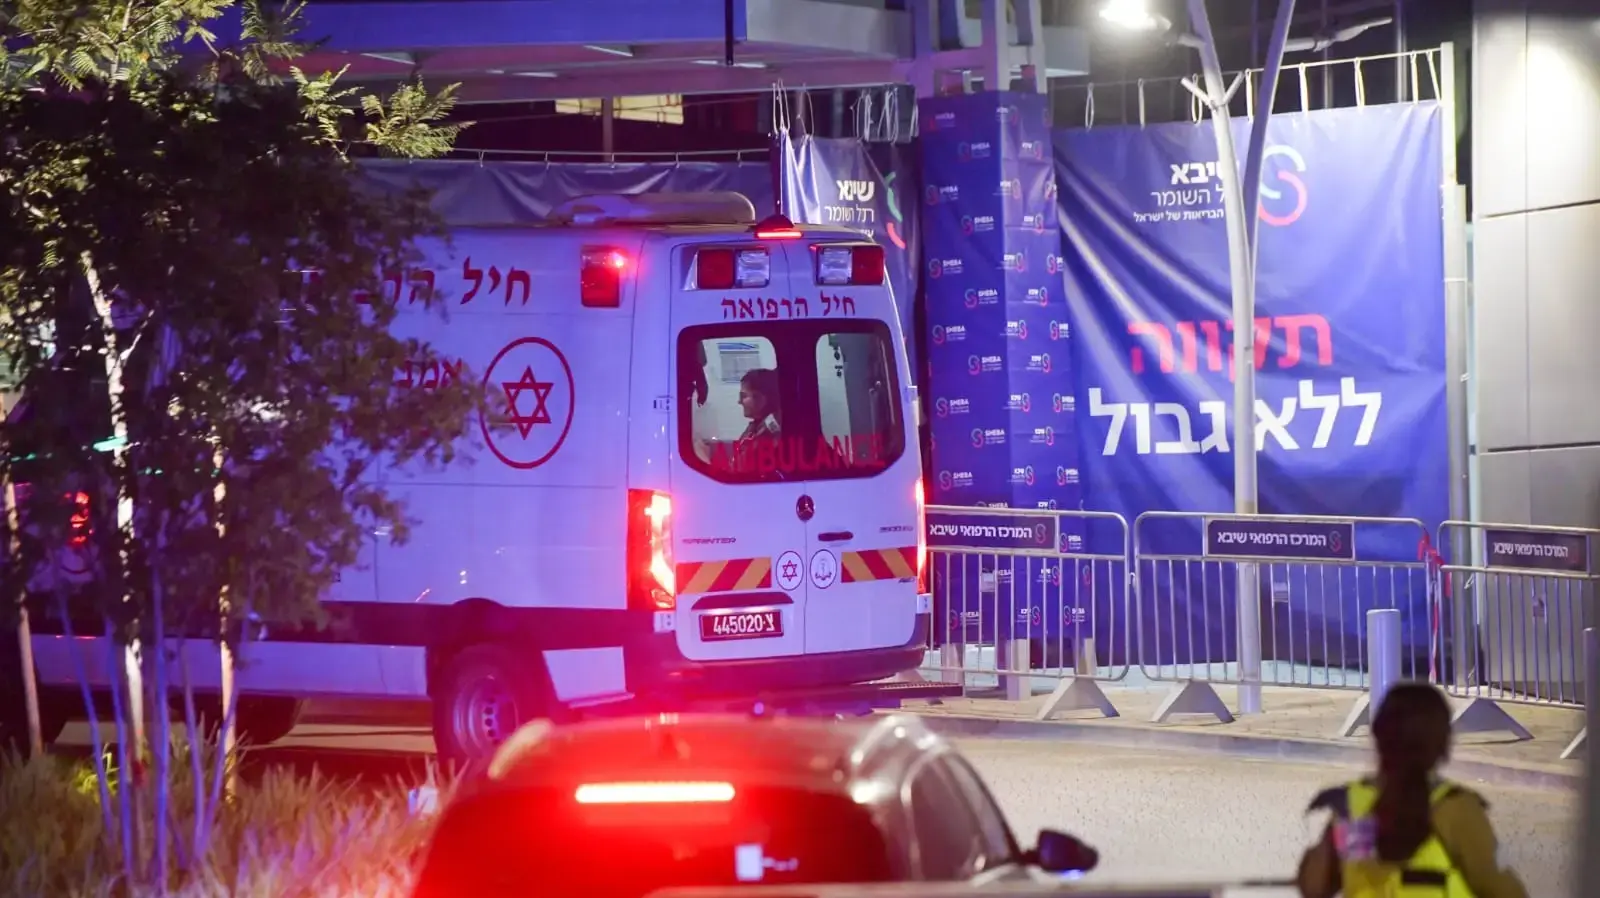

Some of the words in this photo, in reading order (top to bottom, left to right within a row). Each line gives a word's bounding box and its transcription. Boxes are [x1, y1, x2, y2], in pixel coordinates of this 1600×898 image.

[1150, 188, 1211, 207] השומר
[1132, 211, 1164, 223] ישראל
[1165, 210, 1181, 221] של
[1183, 208, 1224, 221] הבריאות
[460, 255, 531, 307] חיל
[721, 297, 809, 319] הרפואה
[819, 290, 856, 316] חיל
[981, 355, 1002, 363] SHEBA
[950, 398, 969, 406] SHEBA
[1254, 376, 1382, 451] ללא
[1088, 387, 1230, 456] גבול
[984, 429, 1005, 437] SHEBA
[710, 434, 886, 474] AMBULANCE
[953, 471, 973, 479] SHEBA
[929, 524, 958, 536] שיבא
[960, 525, 996, 538] הרפואי
[998, 526, 1032, 538] המרכז
[1217, 531, 1247, 544] שיבא
[1249, 532, 1288, 545] הרפואי
[1289, 533, 1327, 546] המרכז
